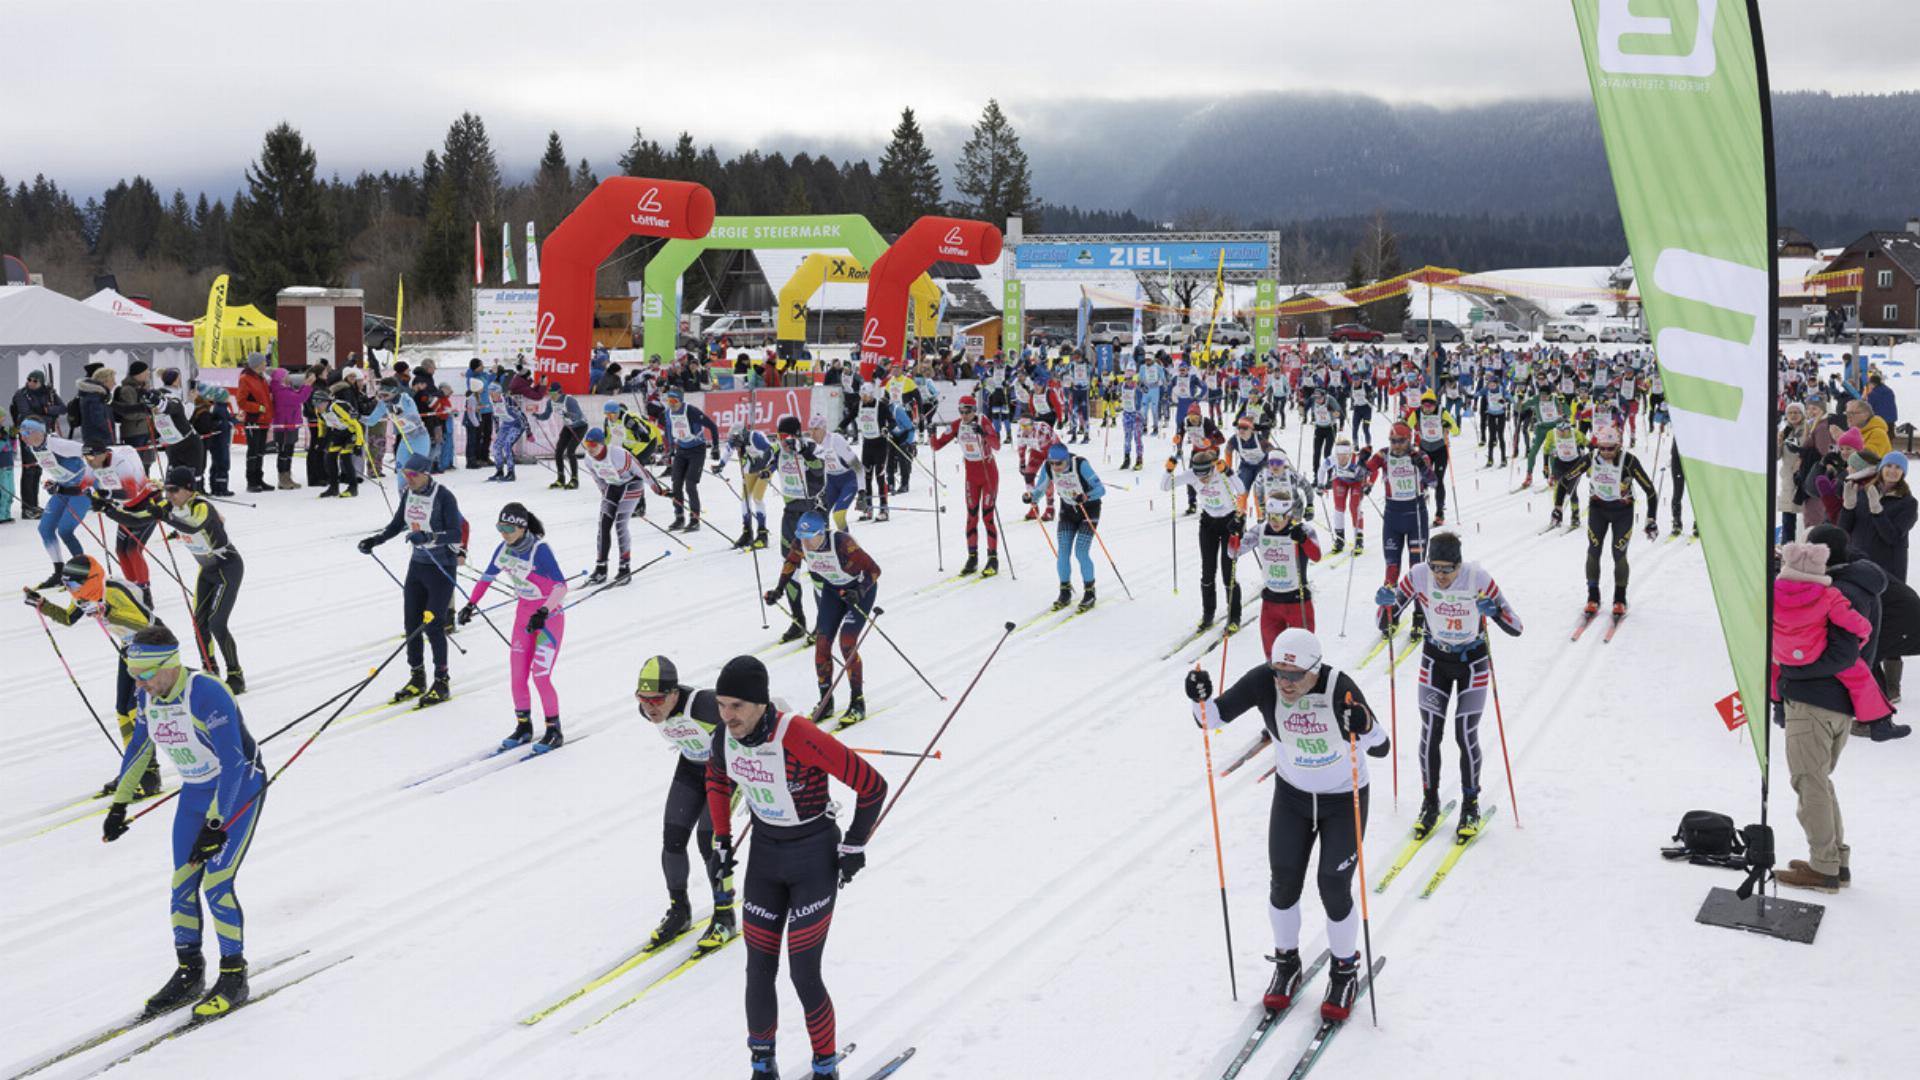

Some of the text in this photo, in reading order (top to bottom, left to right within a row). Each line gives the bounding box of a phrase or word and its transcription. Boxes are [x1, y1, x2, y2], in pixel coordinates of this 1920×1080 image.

[631, 214, 671, 228] Löffler
[754, 223, 841, 240] STEIERMARK
[938, 245, 969, 257] Löffler
[1109, 247, 1167, 266] ZIEL
[211, 297, 231, 366] FISCHER
[534, 357, 580, 375] öffler
[1445, 618, 1464, 631] 78
[1295, 737, 1329, 755] 458
[795, 896, 833, 918] Löffler
